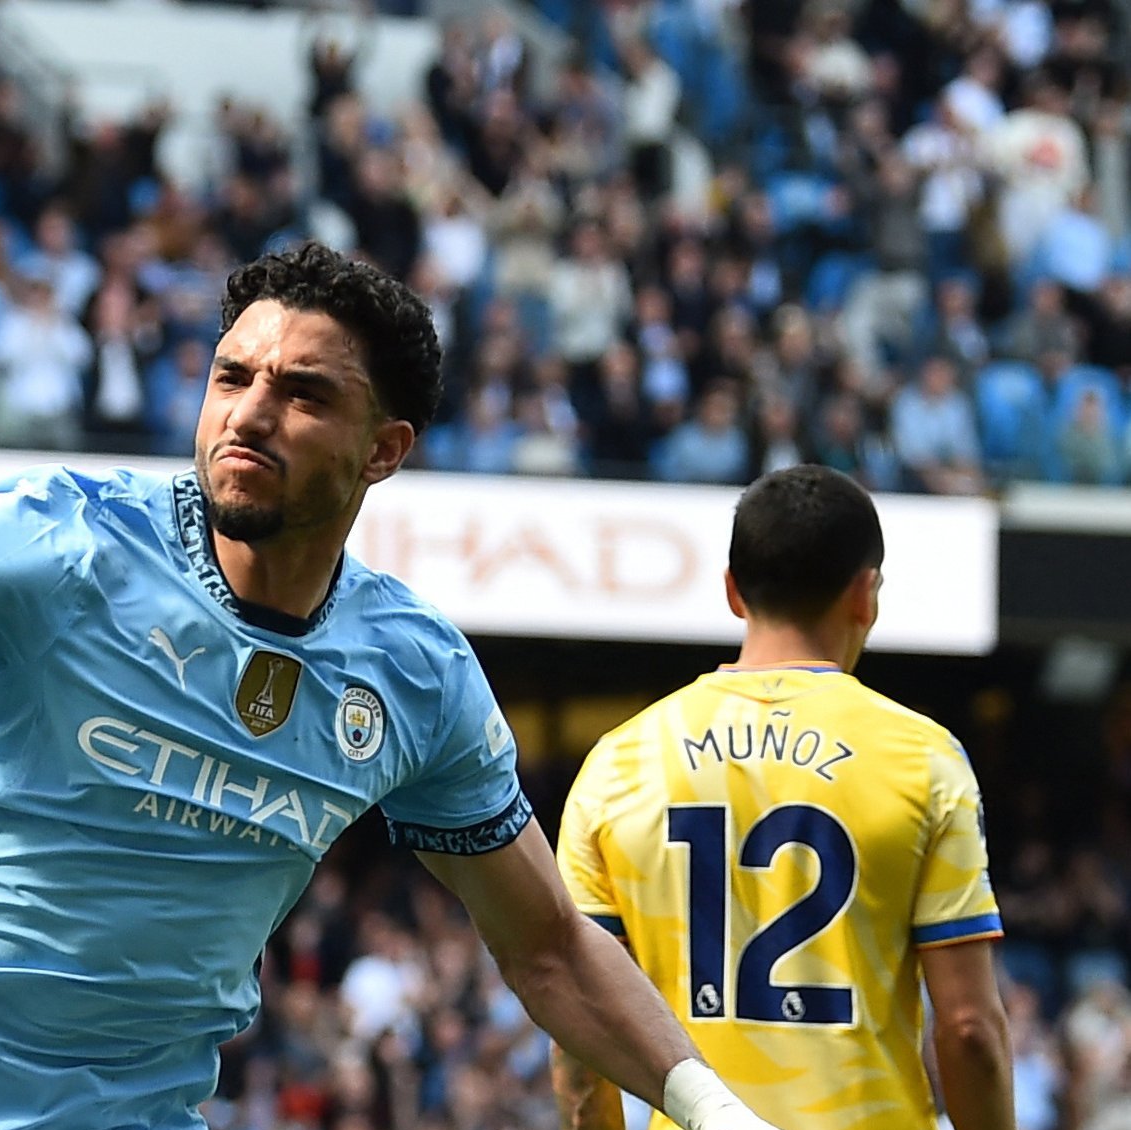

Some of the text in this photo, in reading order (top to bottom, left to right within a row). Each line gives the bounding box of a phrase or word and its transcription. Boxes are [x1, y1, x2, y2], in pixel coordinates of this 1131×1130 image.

[362, 504, 702, 597] IHAD
[248, 702, 274, 720] FIFA
[683, 710, 854, 781] MUÑOZ
[77, 716, 354, 850] ETIHAD
[347, 748, 365, 759] CITY
[666, 803, 858, 1028] 12
